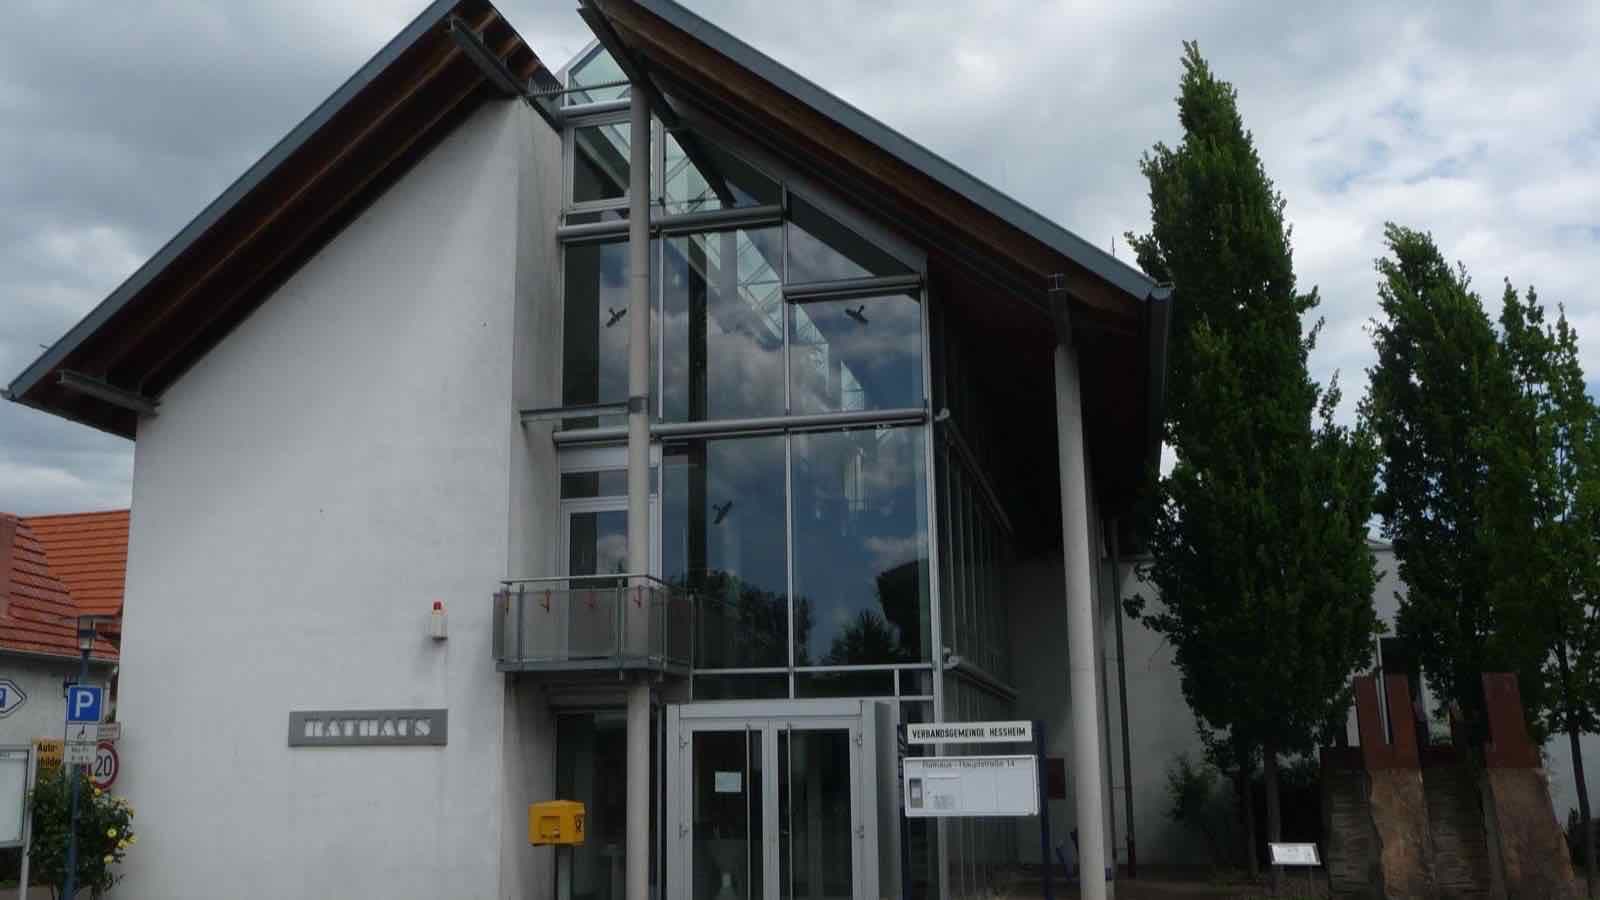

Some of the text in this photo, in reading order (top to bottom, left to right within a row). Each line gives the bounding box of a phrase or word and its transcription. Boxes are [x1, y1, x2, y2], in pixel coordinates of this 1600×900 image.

[75, 690, 94, 718] P
[304, 718, 431, 737] RATHAUS
[989, 727, 1026, 737] HESSHEIM
[95, 755, 112, 776] 20
